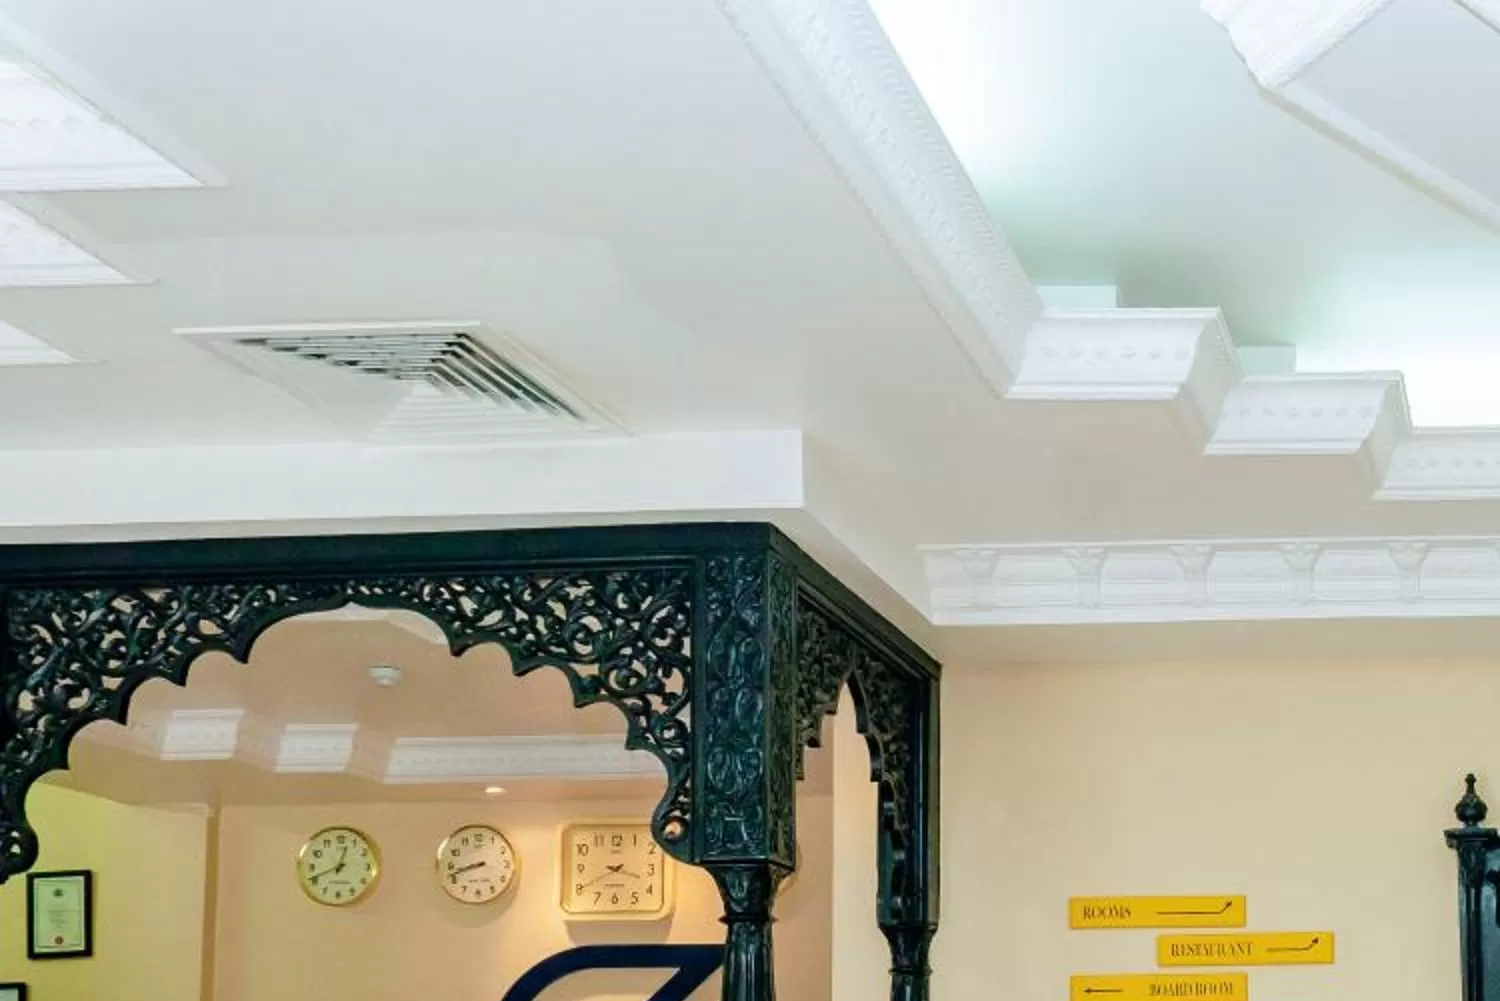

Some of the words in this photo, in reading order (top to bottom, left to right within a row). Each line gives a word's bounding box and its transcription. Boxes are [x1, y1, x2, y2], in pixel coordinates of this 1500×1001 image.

[594, 835, 604, 848] 11
[612, 835, 622, 847] 12
[576, 843, 589, 856] 10
[593, 892, 602, 905] 7
[611, 892, 619, 904] 6
[631, 892, 639, 905] 5
[1082, 904, 1132, 920] ROOMS
[1170, 942, 1253, 957] RESTAURANT
